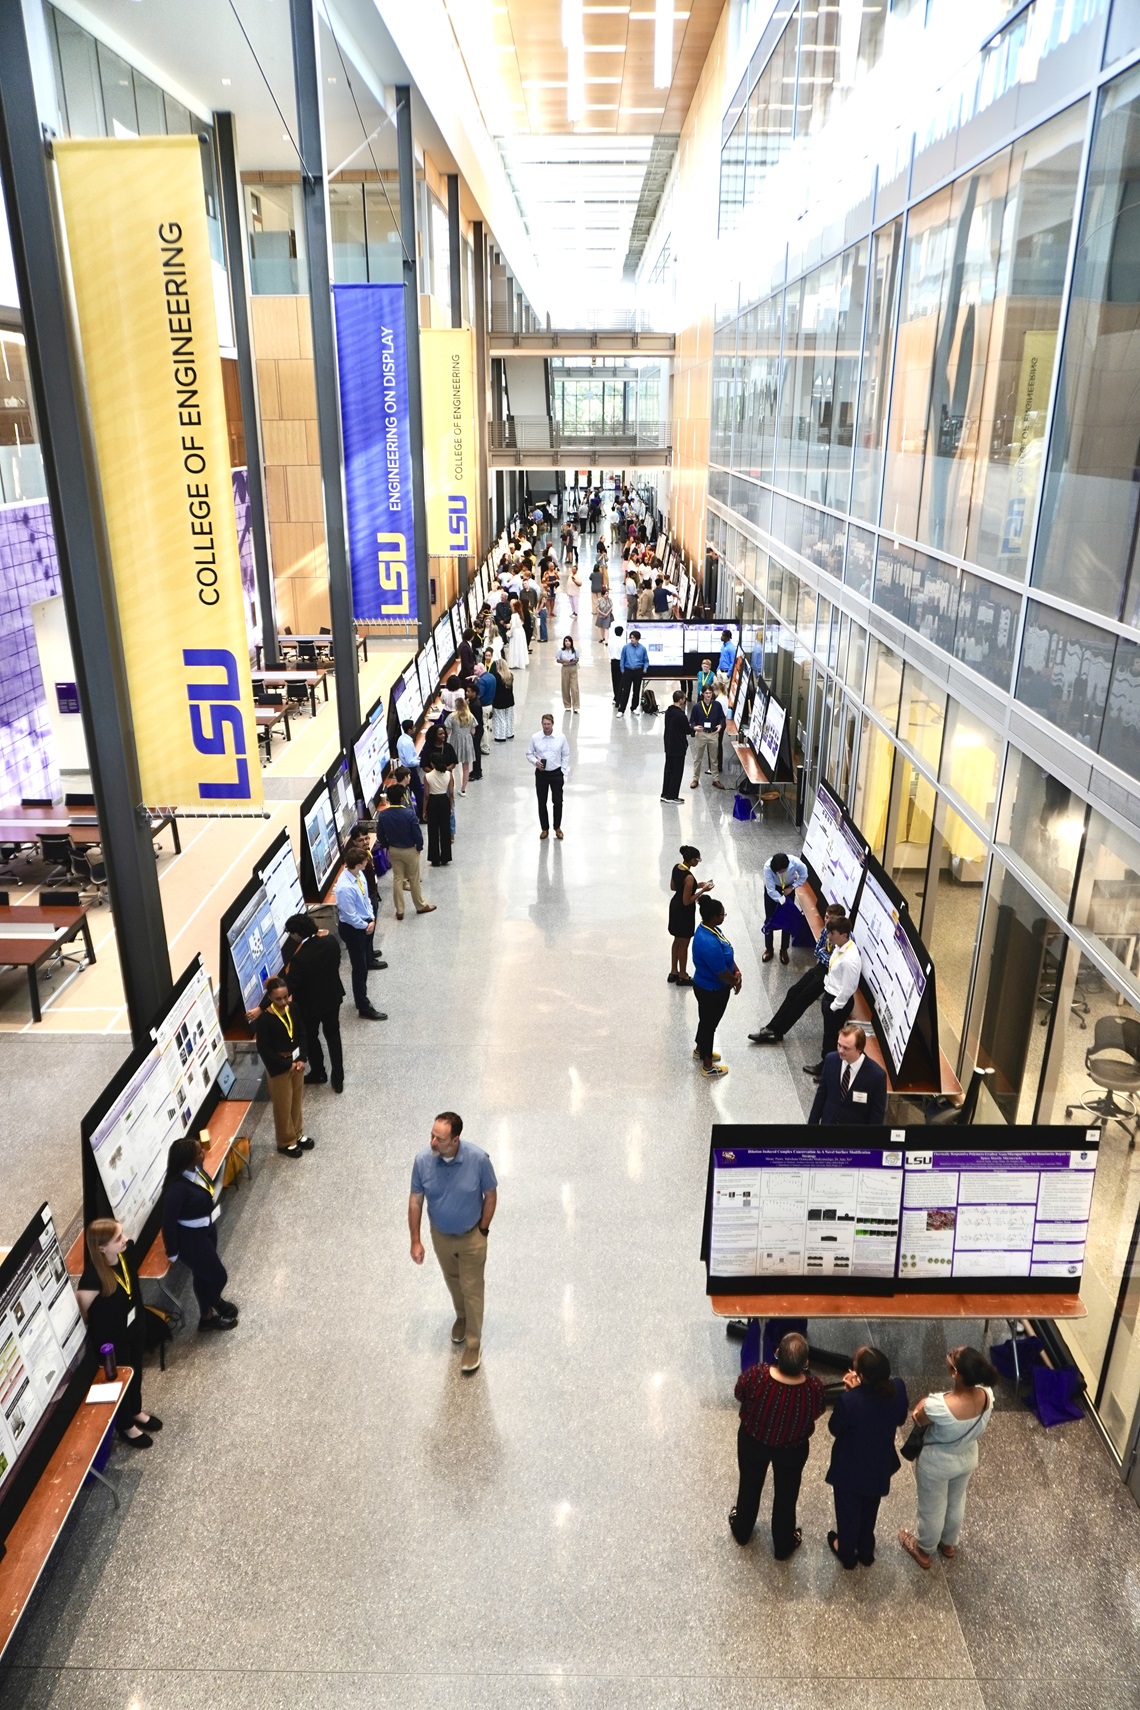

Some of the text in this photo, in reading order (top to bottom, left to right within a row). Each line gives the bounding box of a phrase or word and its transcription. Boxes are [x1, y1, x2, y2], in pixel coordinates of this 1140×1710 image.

[158, 223, 219, 606] COLLEGE OF ENGINEERING
[381, 326, 402, 511] ENGINEERING ON DISPLAY
[451, 353, 463, 481] COLLEGE OF ENGINEERING
[377, 532, 409, 615] LSU
[448, 495, 469, 552] LSU
[182, 649, 251, 799] LSU
[905, 1156, 932, 1165] LSU
